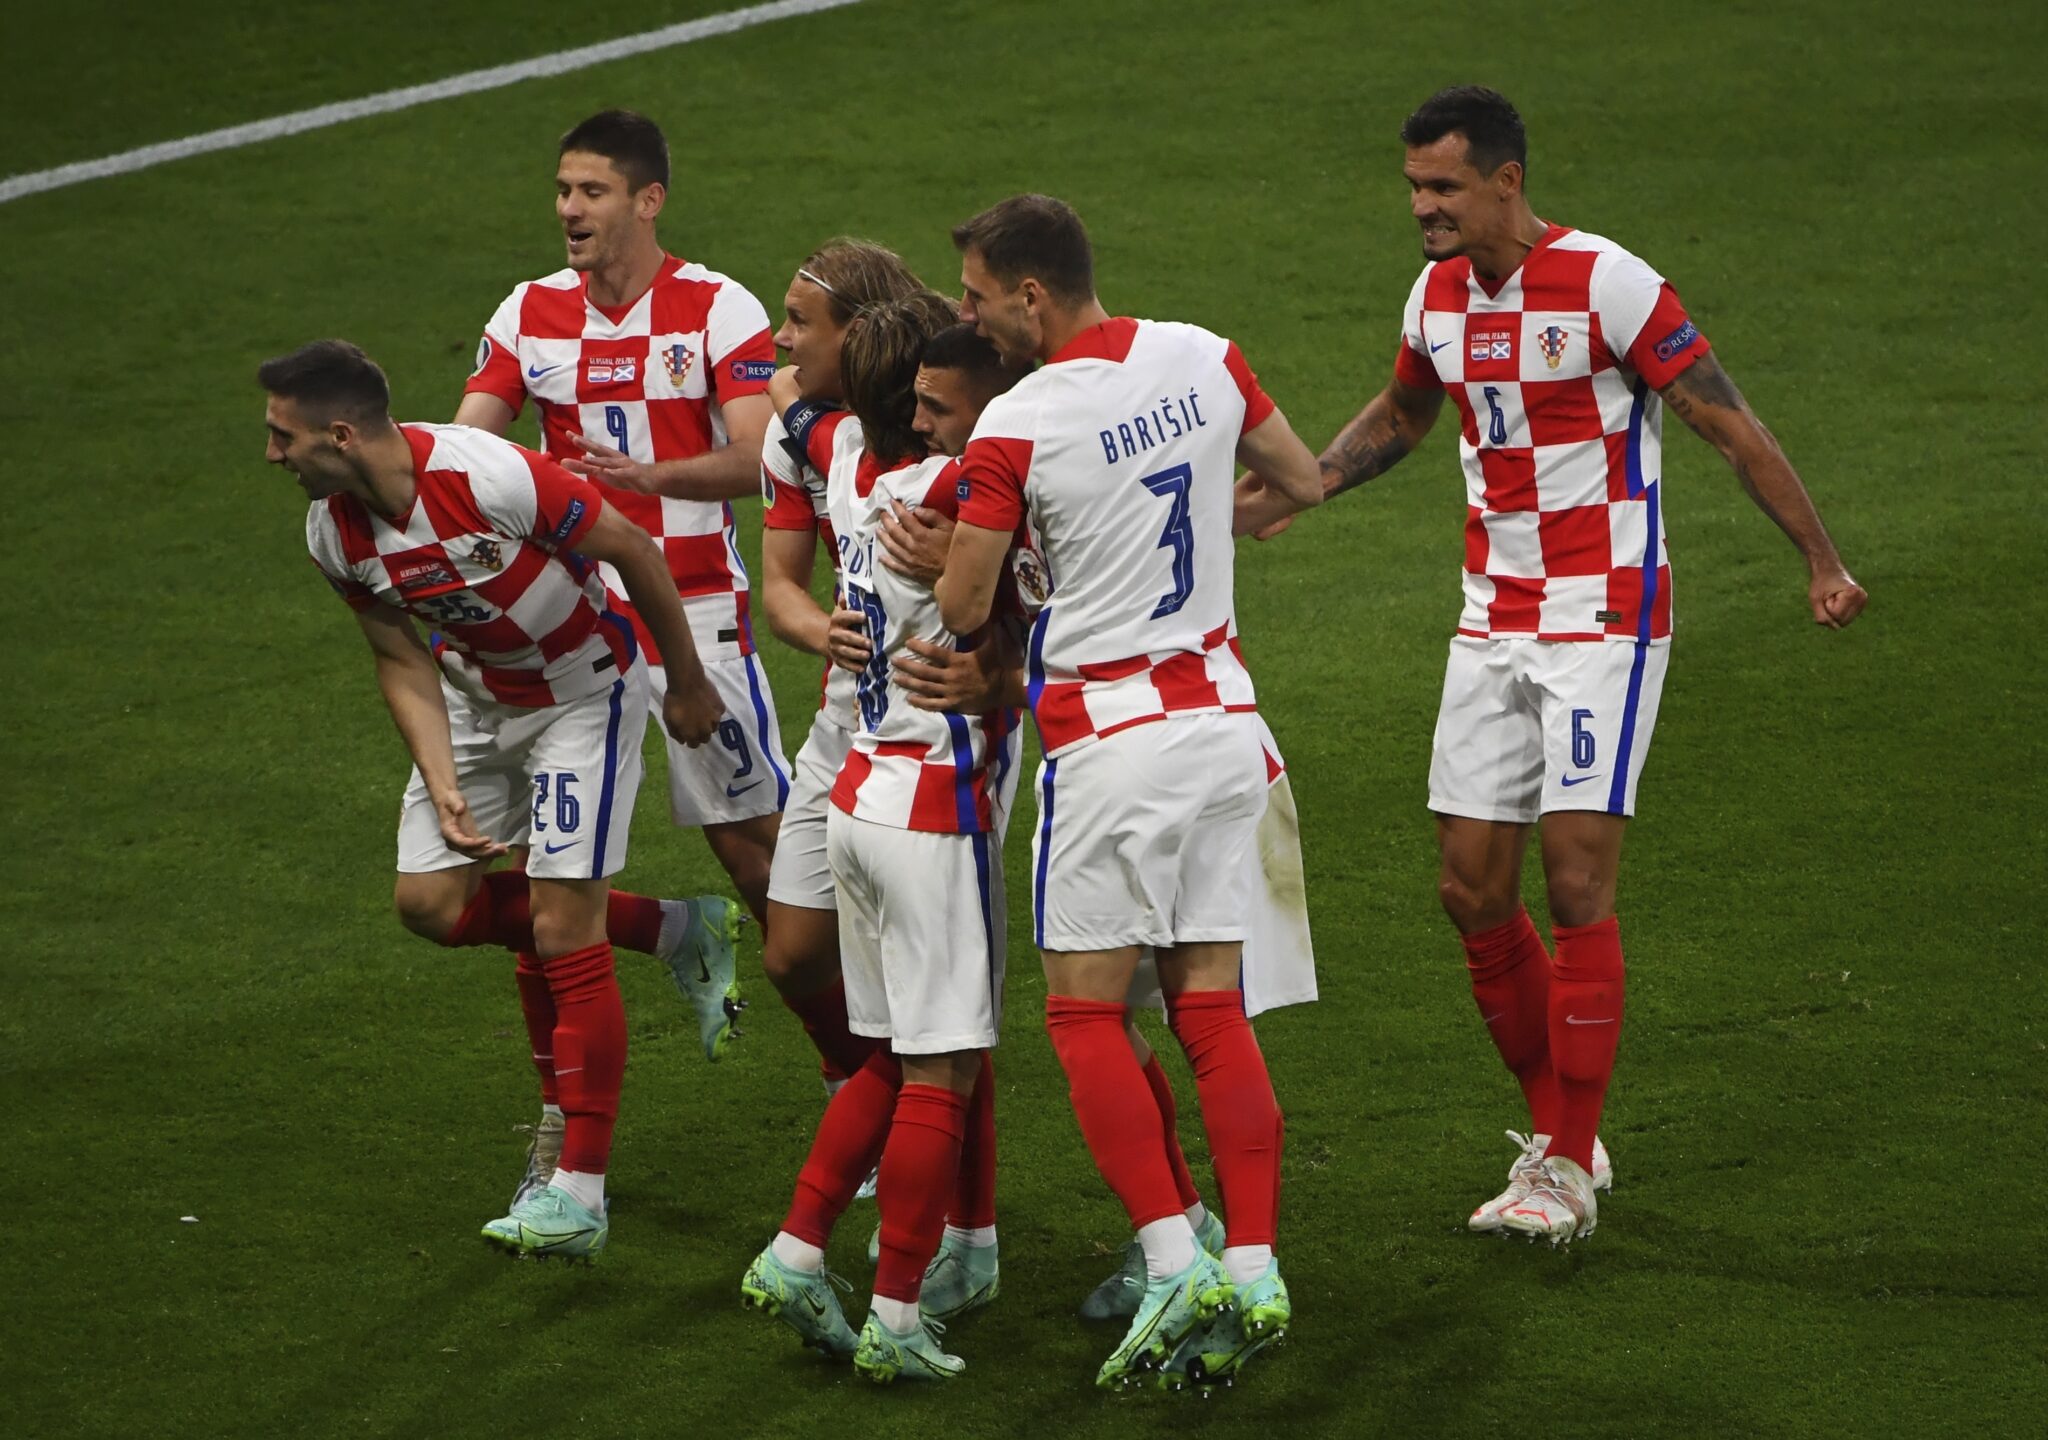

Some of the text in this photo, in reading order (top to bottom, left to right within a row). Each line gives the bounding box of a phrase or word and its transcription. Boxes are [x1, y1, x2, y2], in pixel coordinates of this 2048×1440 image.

[748, 366, 778, 377] RESPE
[604, 405, 630, 456] 9
[1099, 387, 1207, 465] BARIŠIĆ
[1483, 386, 1508, 446] 6
[1139, 461, 1195, 621] 3
[718, 718, 754, 779] 9
[1571, 708, 1596, 769] 6
[534, 772, 581, 834] 26
